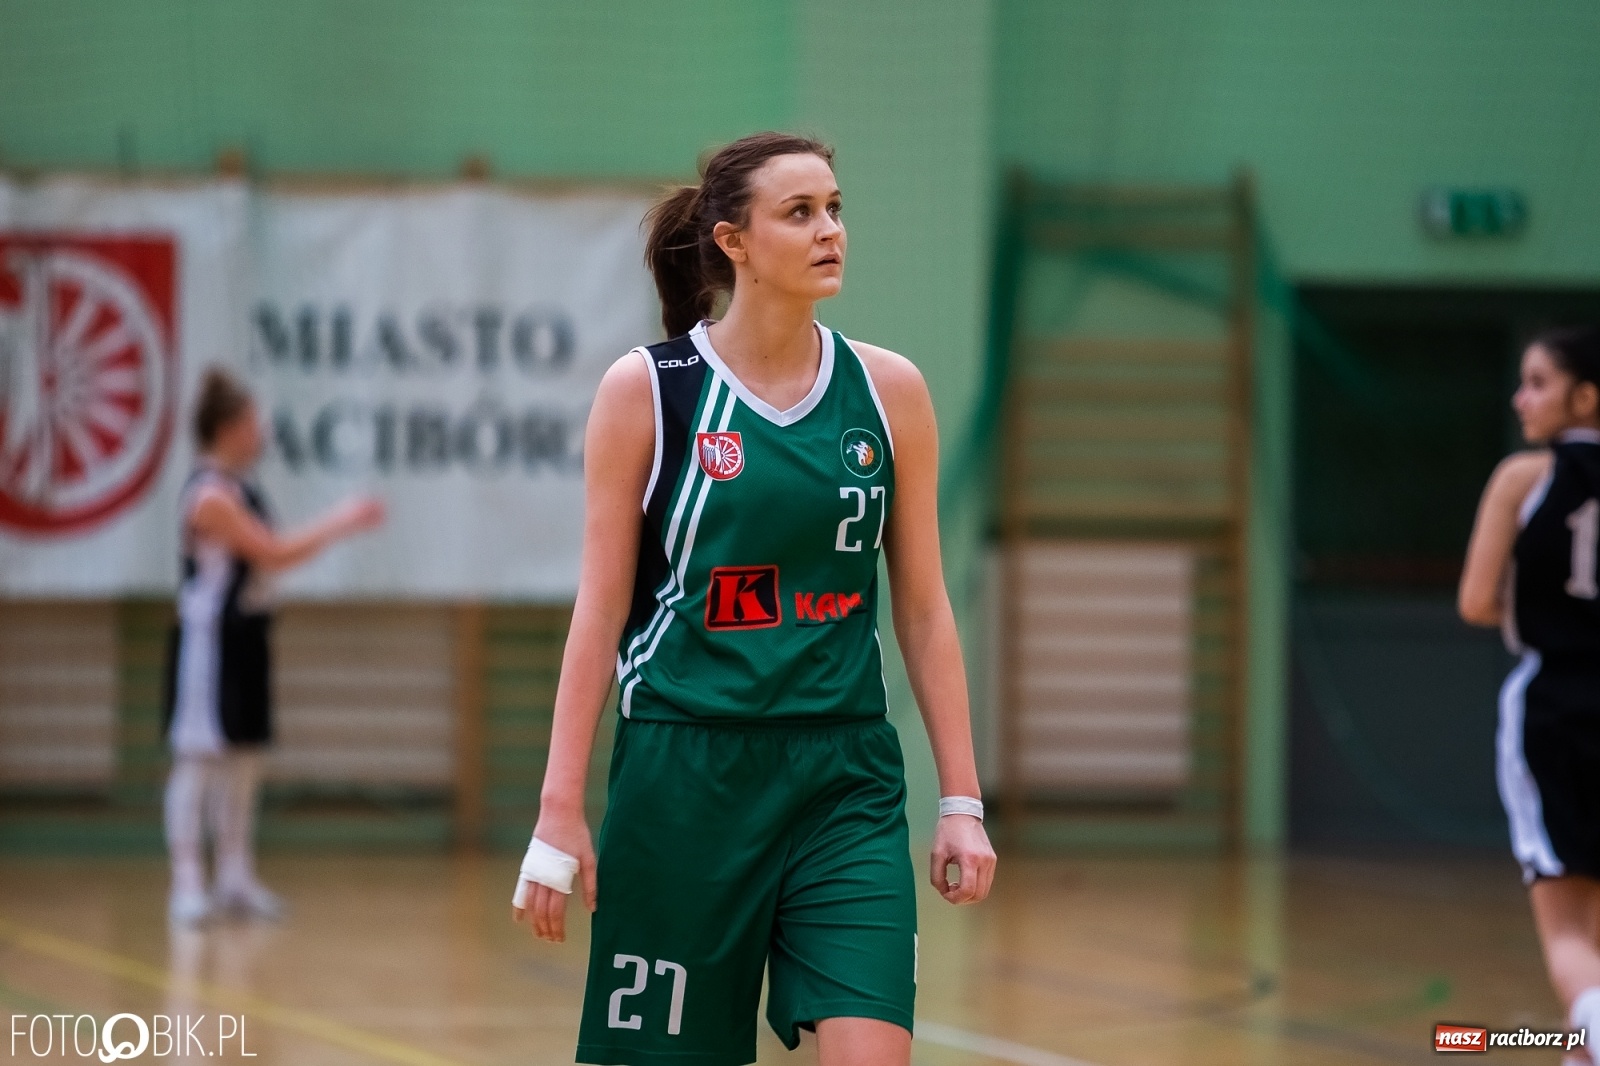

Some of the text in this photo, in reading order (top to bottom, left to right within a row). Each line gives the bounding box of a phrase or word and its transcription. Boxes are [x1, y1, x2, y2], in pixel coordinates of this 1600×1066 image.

[251, 302, 577, 371] MIASTO
[658, 354, 699, 368] COLO
[268, 395, 584, 474] ACIBÓR
[835, 486, 886, 552] 27
[711, 573, 775, 622] K
[607, 953, 688, 1036] 27
